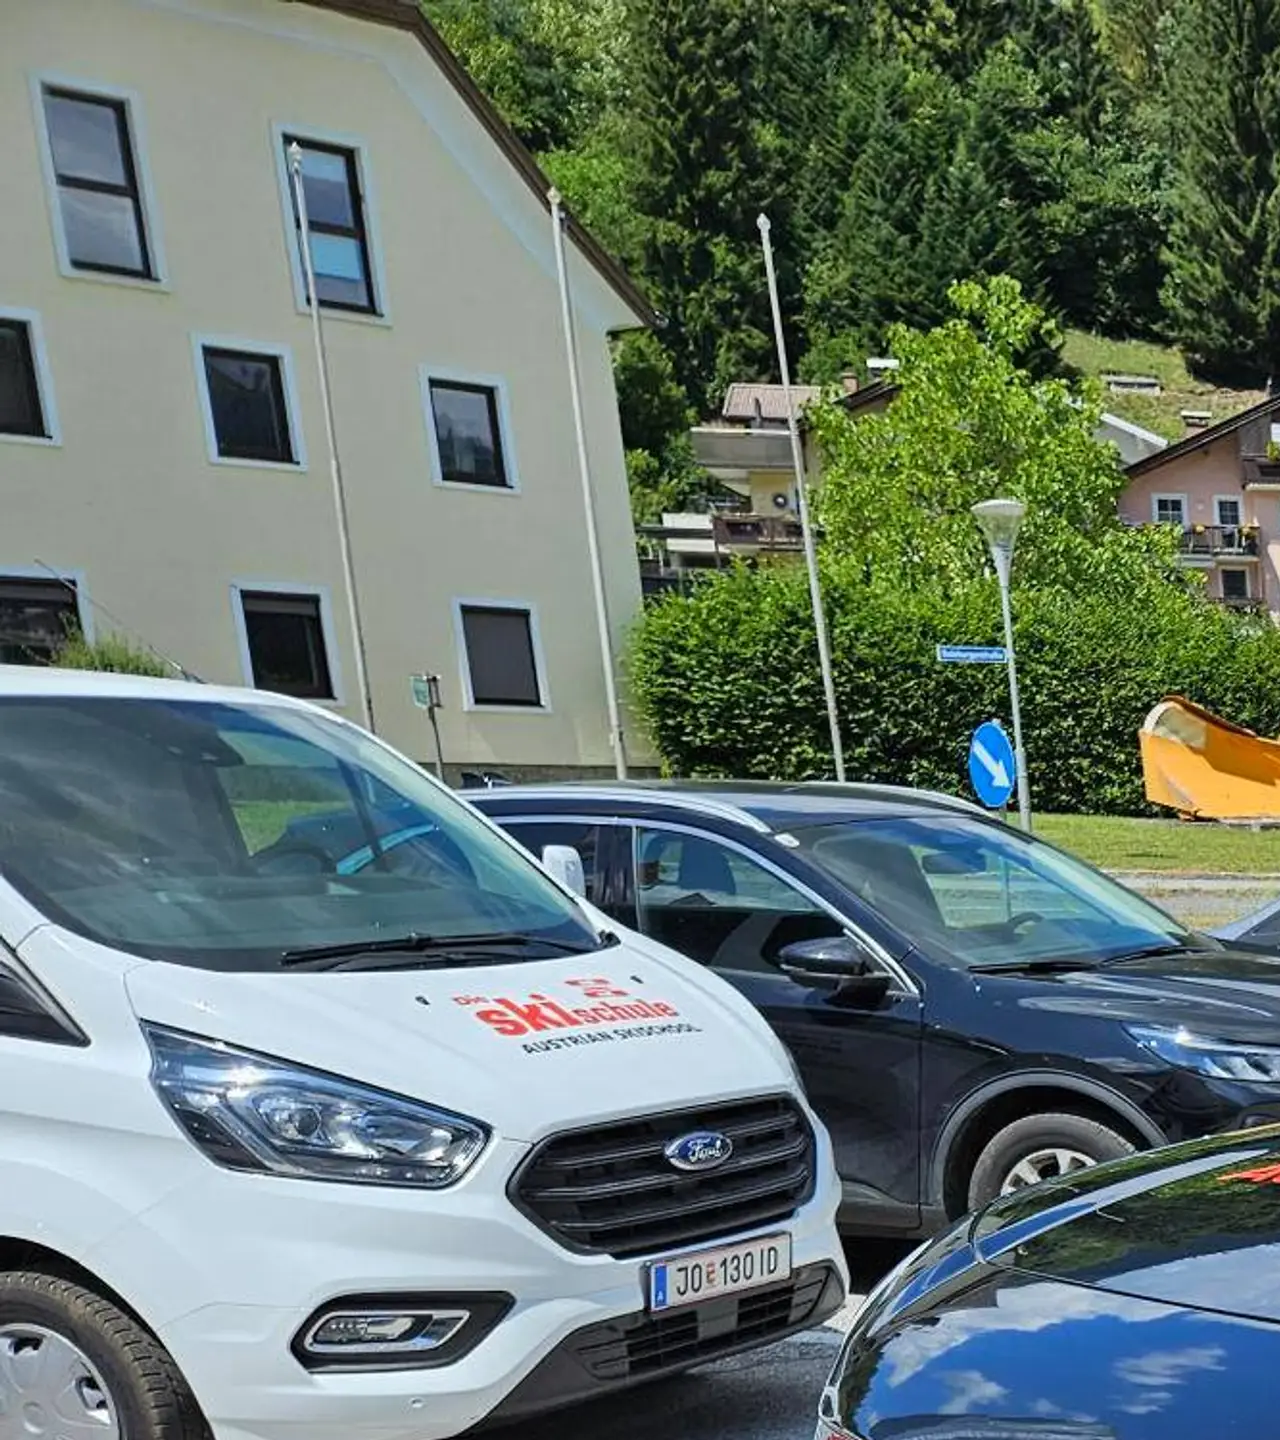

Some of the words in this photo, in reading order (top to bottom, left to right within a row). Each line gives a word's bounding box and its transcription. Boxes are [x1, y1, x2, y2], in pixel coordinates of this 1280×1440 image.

[521, 1031, 613, 1054] AUSTRIAN
[613, 1023, 703, 1040] SKISCHOOL
[676, 1263, 703, 1296] JO
[720, 1251, 754, 1286] 130
